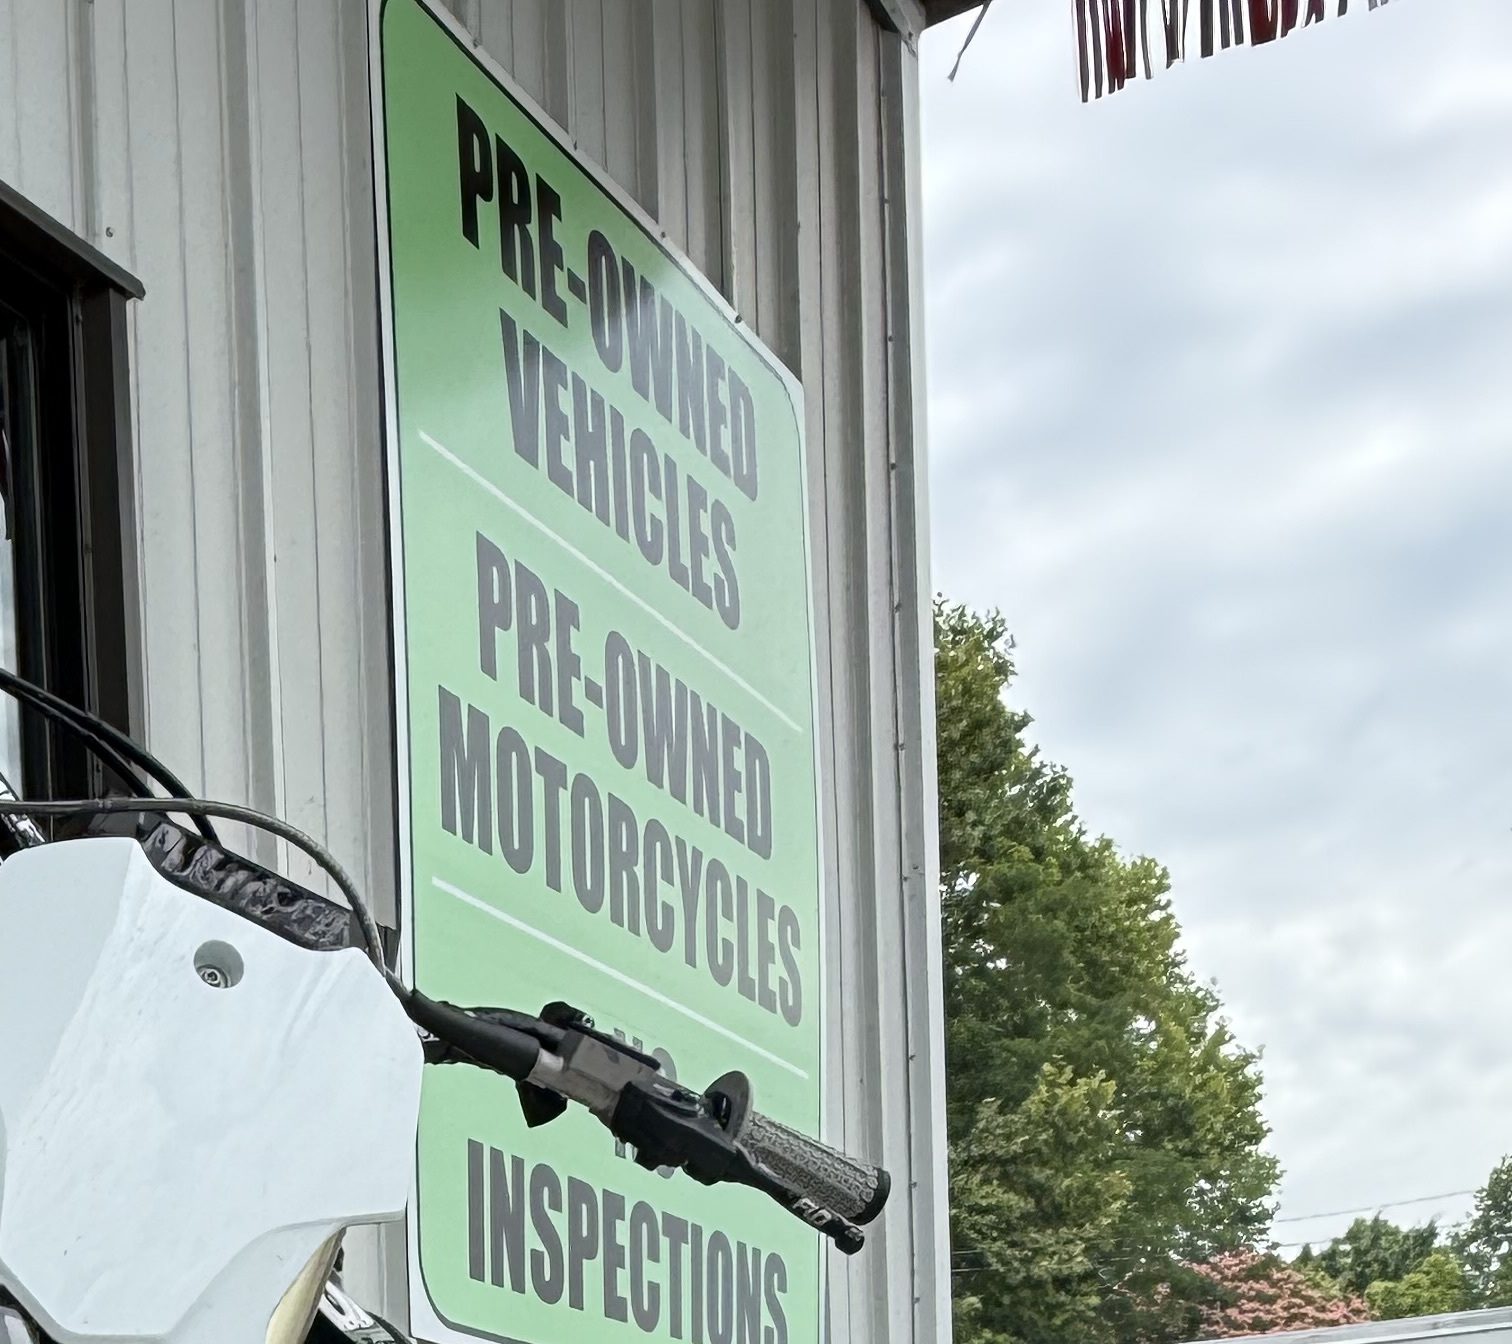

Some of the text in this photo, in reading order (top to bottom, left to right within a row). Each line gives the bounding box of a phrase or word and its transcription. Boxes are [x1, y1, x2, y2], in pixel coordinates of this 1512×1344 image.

[455, 92, 758, 502] PRE-OWNED
[498, 306, 741, 630] VEHICLES
[437, 684, 802, 1028] MOTORCYCLES
[475, 529, 773, 861] PRE-OWNED
